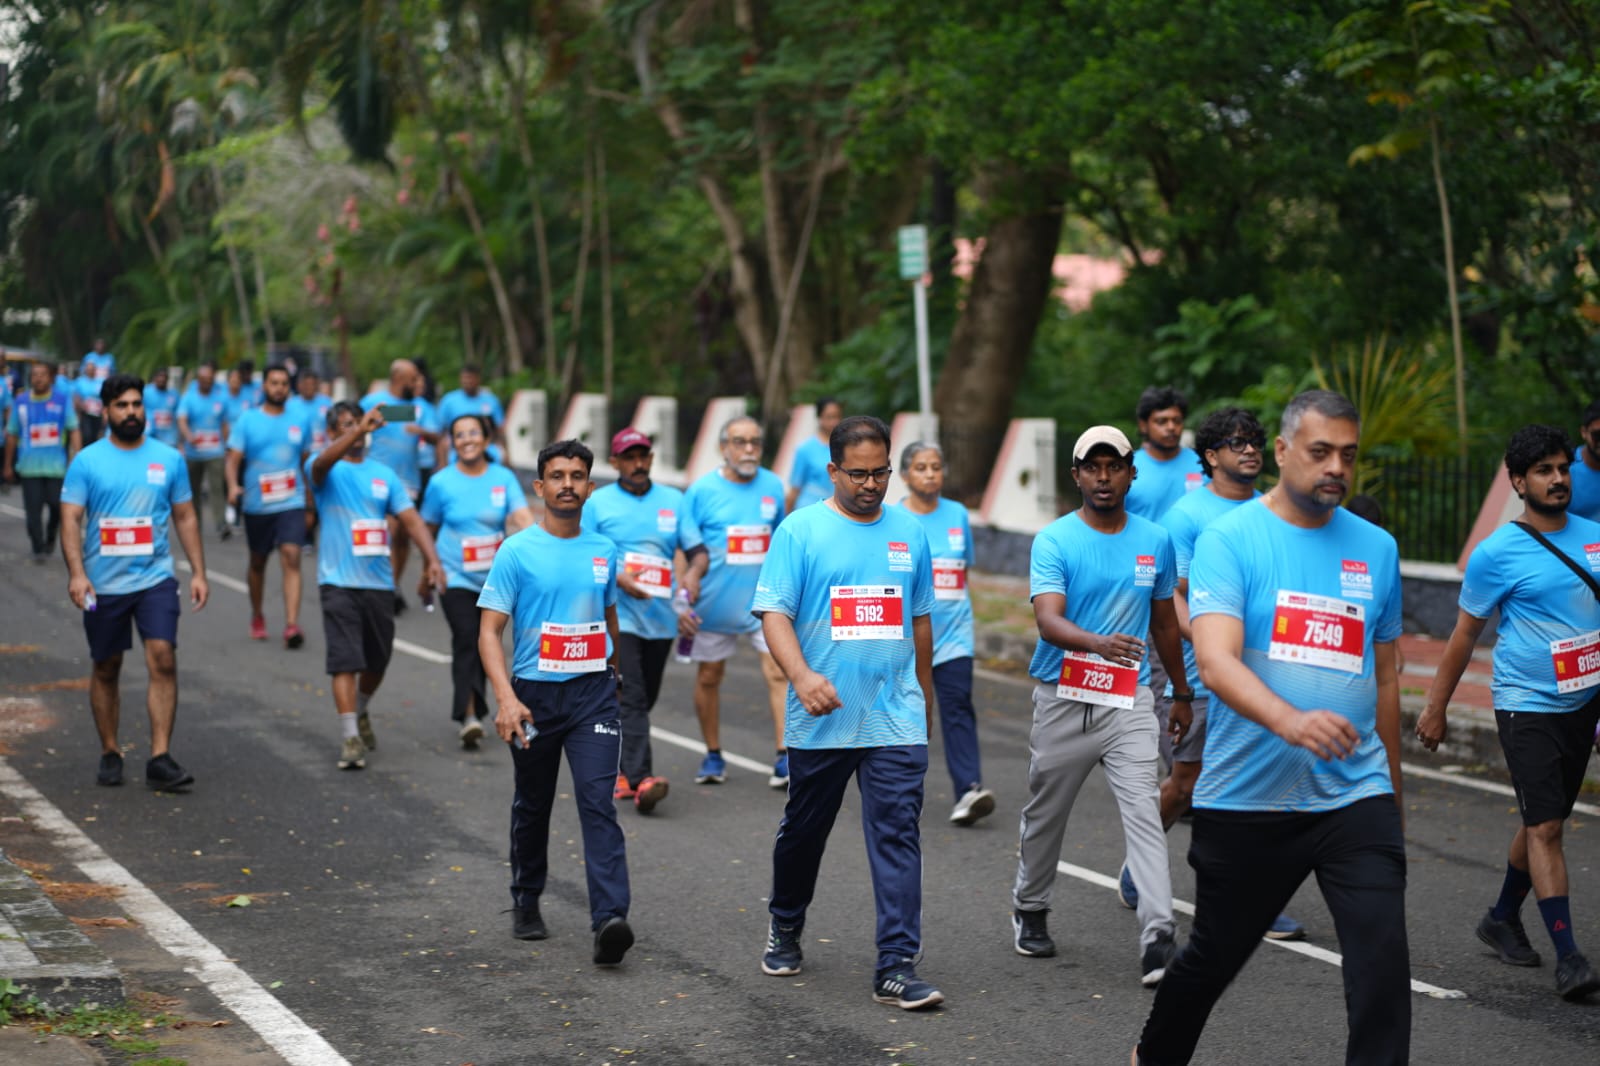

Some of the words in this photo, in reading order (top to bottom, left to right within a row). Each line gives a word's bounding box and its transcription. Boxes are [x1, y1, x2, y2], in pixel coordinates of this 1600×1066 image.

[855, 604, 884, 622] 5192
[1303, 619, 1344, 647] 7549
[562, 641, 588, 658] 7331
[1081, 669, 1115, 690] 7323
